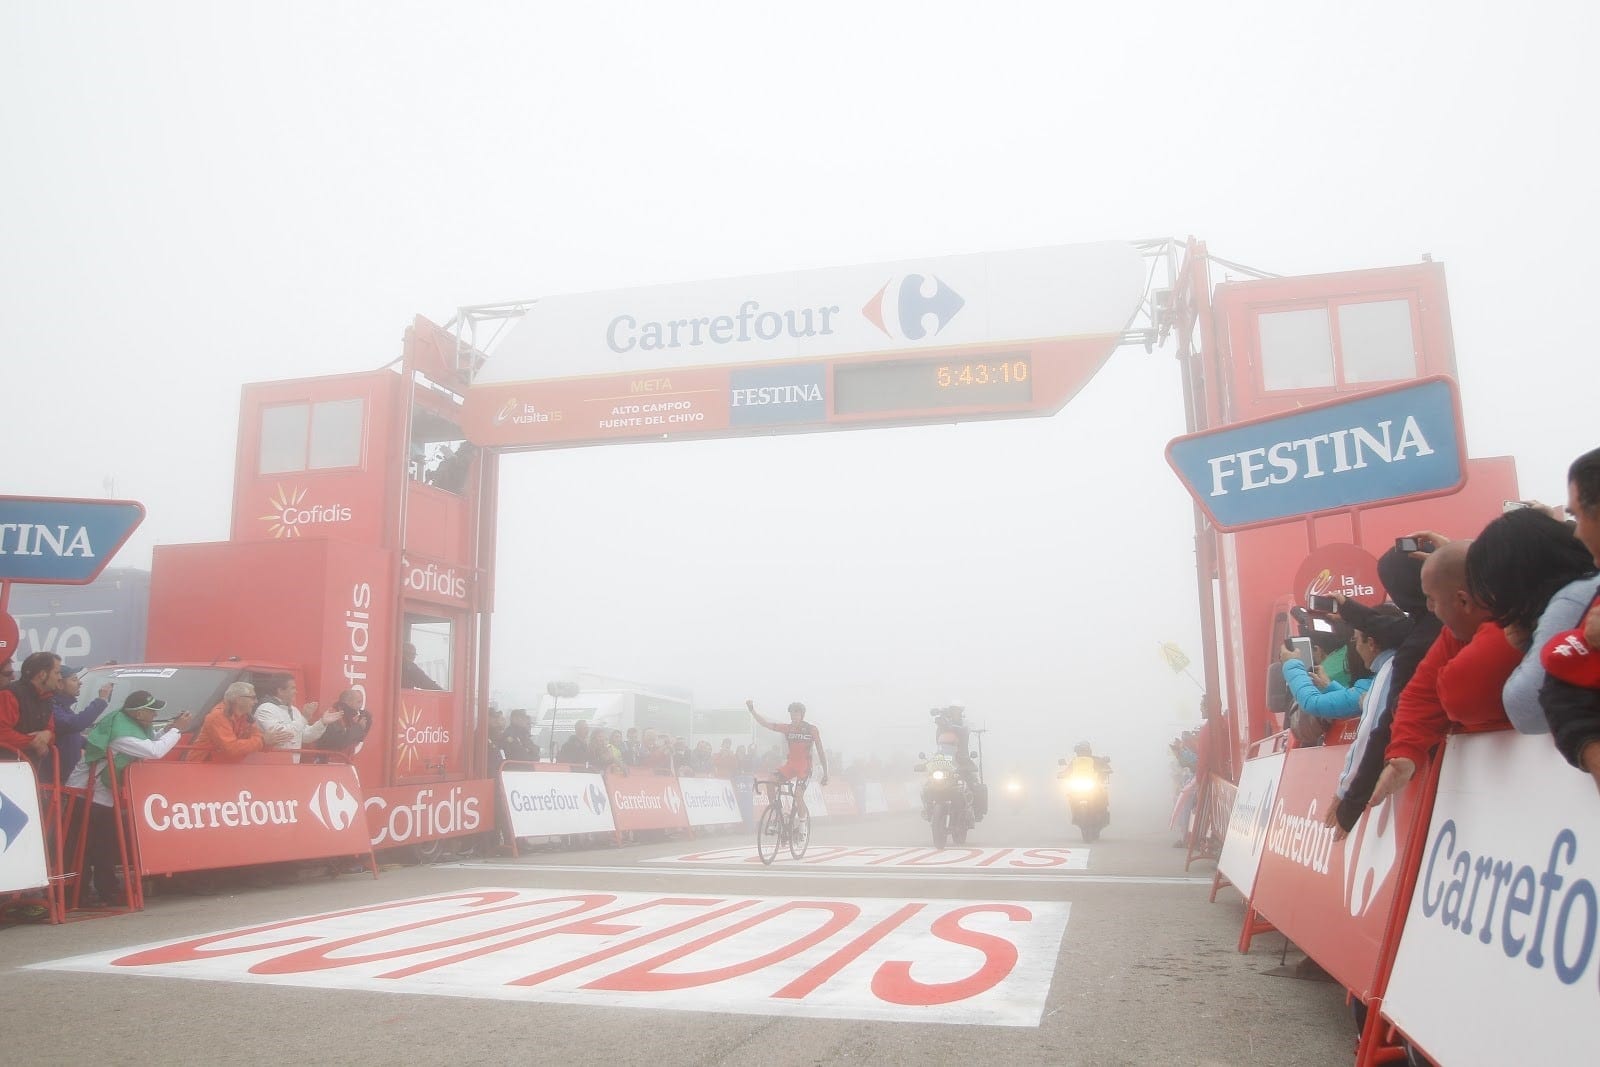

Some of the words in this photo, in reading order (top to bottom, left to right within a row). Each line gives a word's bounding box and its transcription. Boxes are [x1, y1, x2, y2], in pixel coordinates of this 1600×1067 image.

[606, 300, 840, 354] Carrefour
[630, 377, 673, 393] META
[936, 361, 1028, 388] 5:43:10
[732, 384, 823, 407] FESTINA
[524, 403, 536, 414] la
[612, 404, 640, 415] ALTO
[642, 401, 692, 412] CAMPOO
[599, 417, 642, 429] FUENTE
[645, 415, 666, 426] DEL
[668, 412, 704, 424] CHIVO
[1207, 415, 1434, 497] FESTINA
[282, 503, 352, 525] Cofidis
[1341, 575, 1355, 586] la
[406, 725, 450, 745] Cofidis
[510, 783, 580, 812] Carrefour
[614, 789, 661, 810] Carrefour
[144, 790, 298, 831] Carrefour
[1268, 798, 1338, 874] Carrefour
[677, 846, 1071, 868] COFIDIS
[1422, 819, 1600, 986] Carrefo
[111, 891, 1034, 1006] COFIDIS
